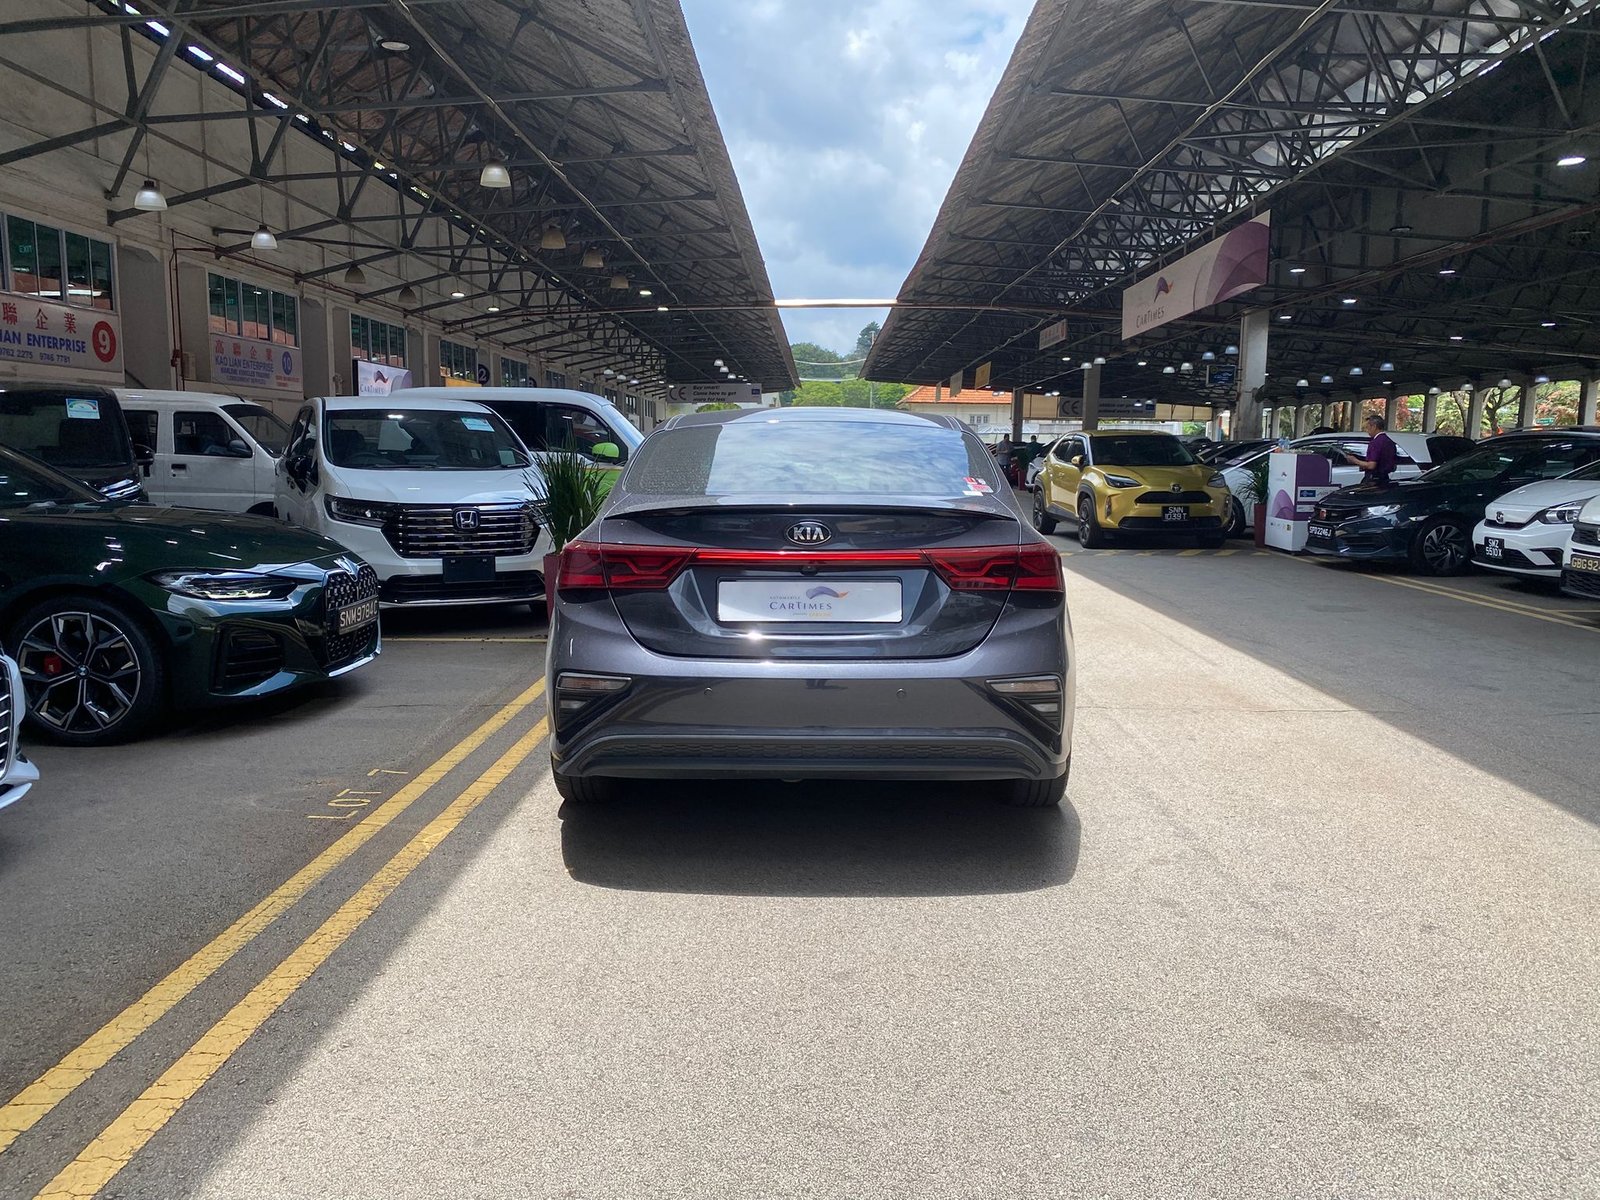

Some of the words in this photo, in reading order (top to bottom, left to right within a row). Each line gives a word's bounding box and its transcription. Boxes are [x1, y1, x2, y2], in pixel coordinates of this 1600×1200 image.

[19, 245, 31, 253] EXIT
[27, 333, 86, 353] ENTERPRISE
[98, 330, 110, 354] 9
[243, 359, 274, 373] ENTERPRISE
[793, 526, 824, 540] KIA
[1571, 557, 1600, 571] GBG92
[769, 601, 832, 610] CARTIMES
[340, 600, 378, 627] SNM9784C
